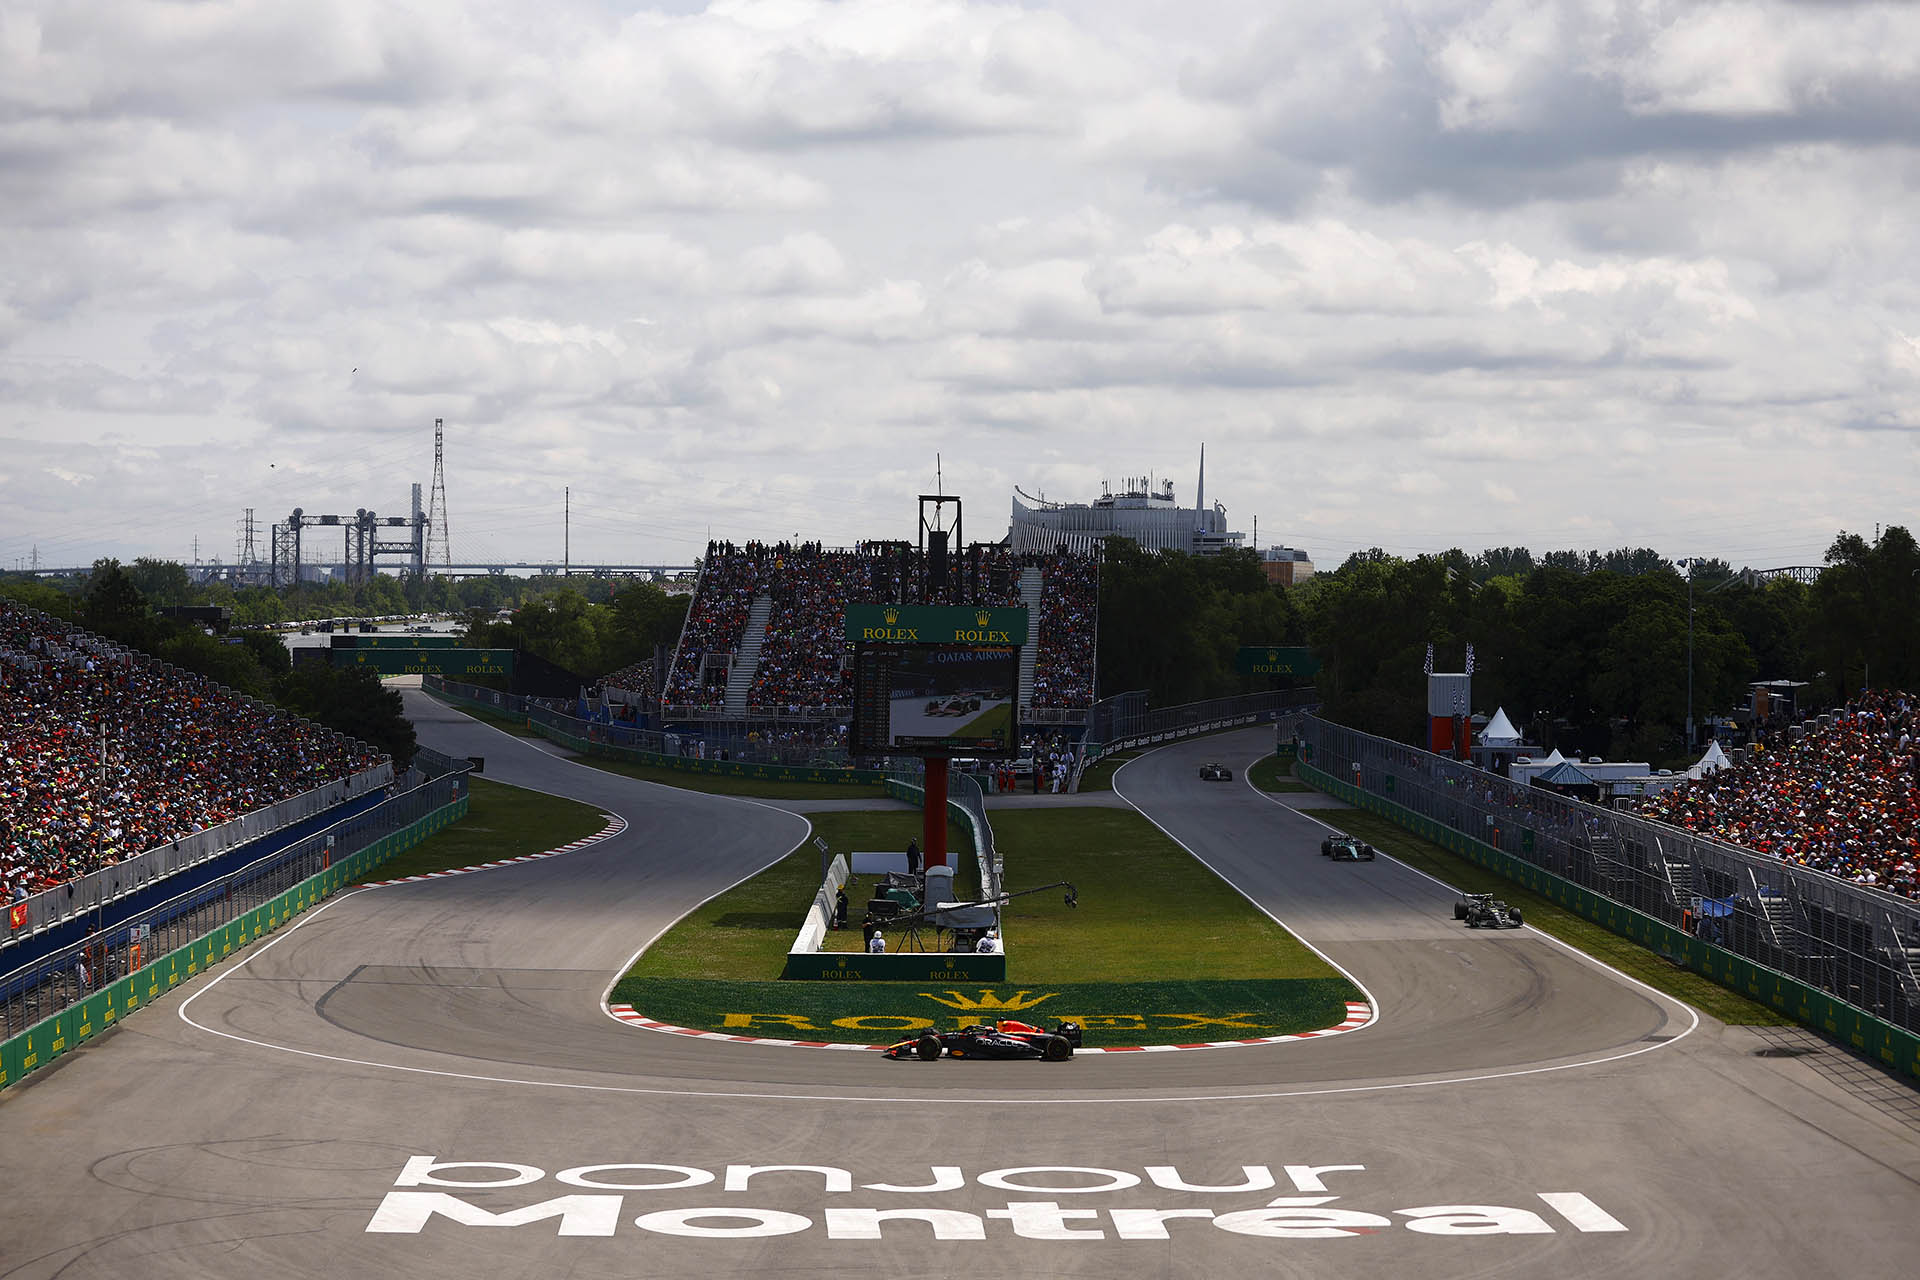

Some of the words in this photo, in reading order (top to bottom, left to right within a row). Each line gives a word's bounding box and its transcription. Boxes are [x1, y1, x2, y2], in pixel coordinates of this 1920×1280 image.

[863, 627, 919, 640] ROLEX
[955, 629, 1011, 642] ROLEX
[937, 651, 973, 664] QATAR
[405, 664, 441, 673] ROLEX
[466, 664, 504, 673] ROLEX
[1253, 663, 1293, 673] ROLEX
[821, 970, 862, 979] ROLEX
[930, 970, 969, 980] ROLEX
[393, 1155, 1366, 1193] bonjour
[366, 1192, 1629, 1239] Montréal
